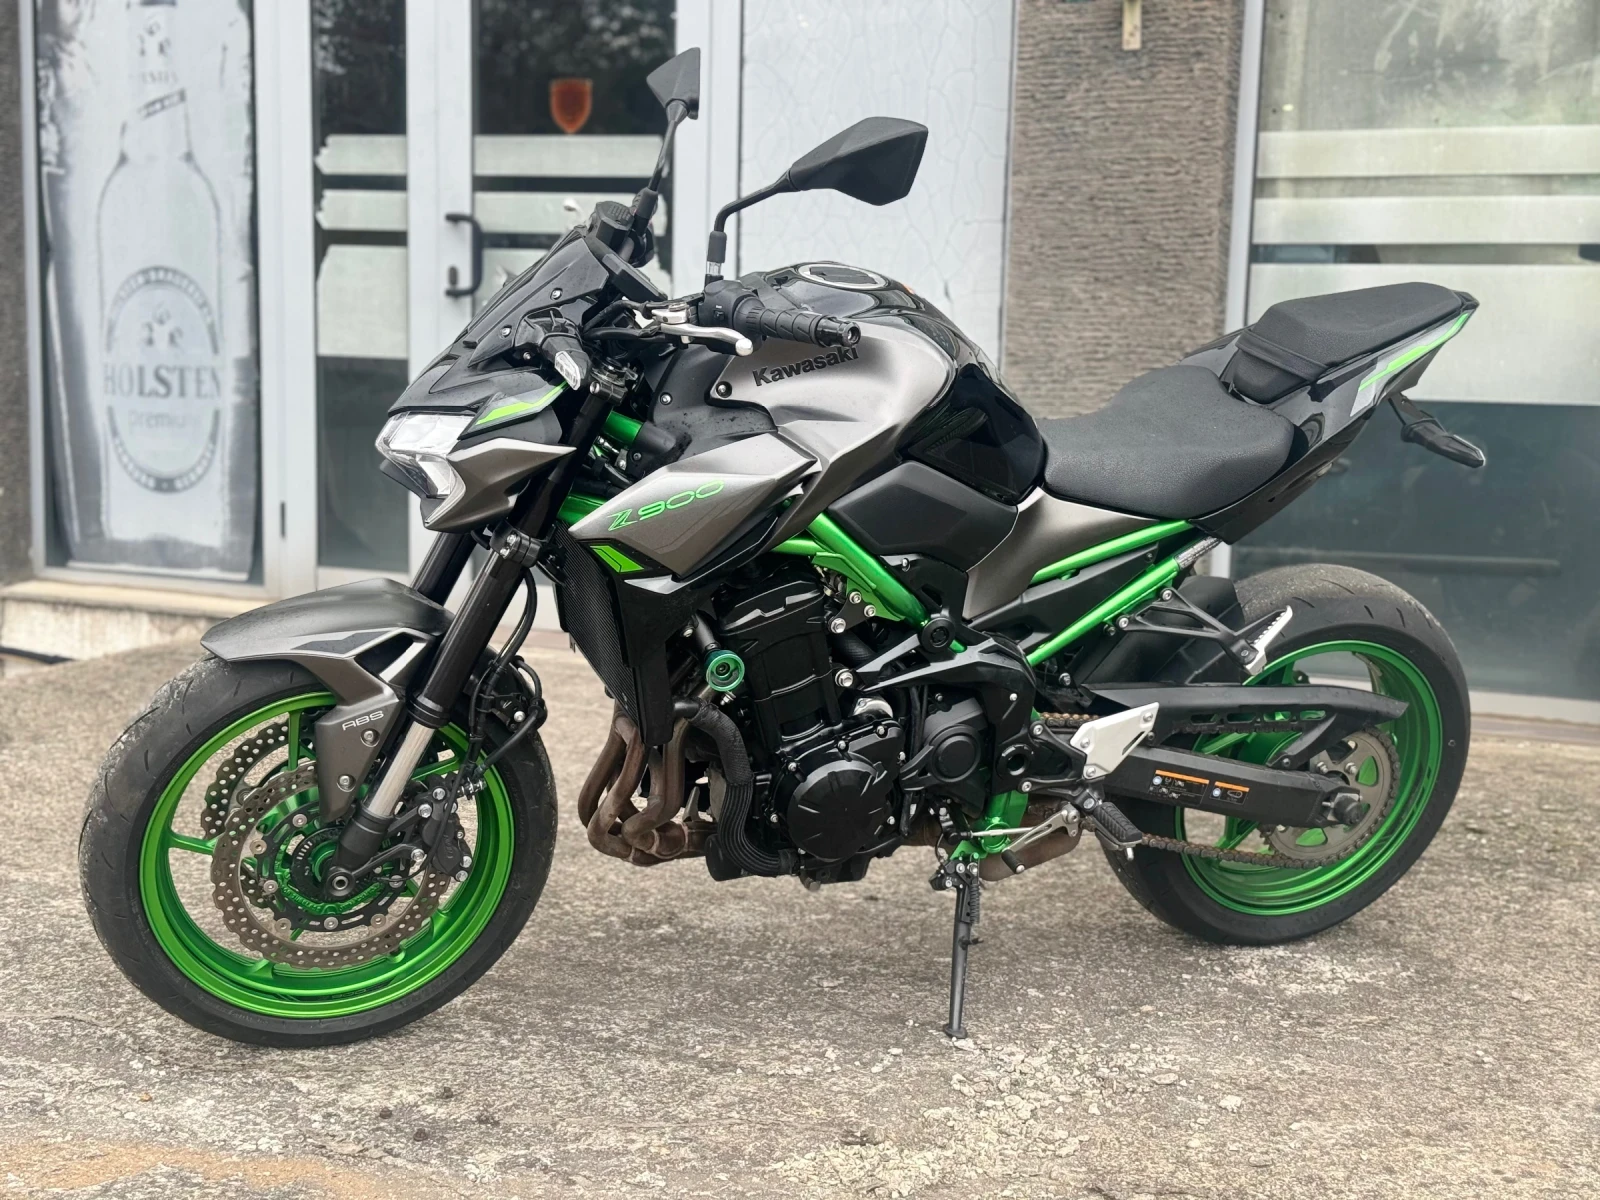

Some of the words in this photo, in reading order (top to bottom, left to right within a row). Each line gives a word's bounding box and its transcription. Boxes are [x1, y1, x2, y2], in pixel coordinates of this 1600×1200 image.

[103, 362, 222, 399] HOLSTEN
[752, 347, 859, 387] Kawasaki
[127, 409, 201, 436] premiu
[607, 480, 725, 532] Z900
[342, 710, 384, 731] ABS
